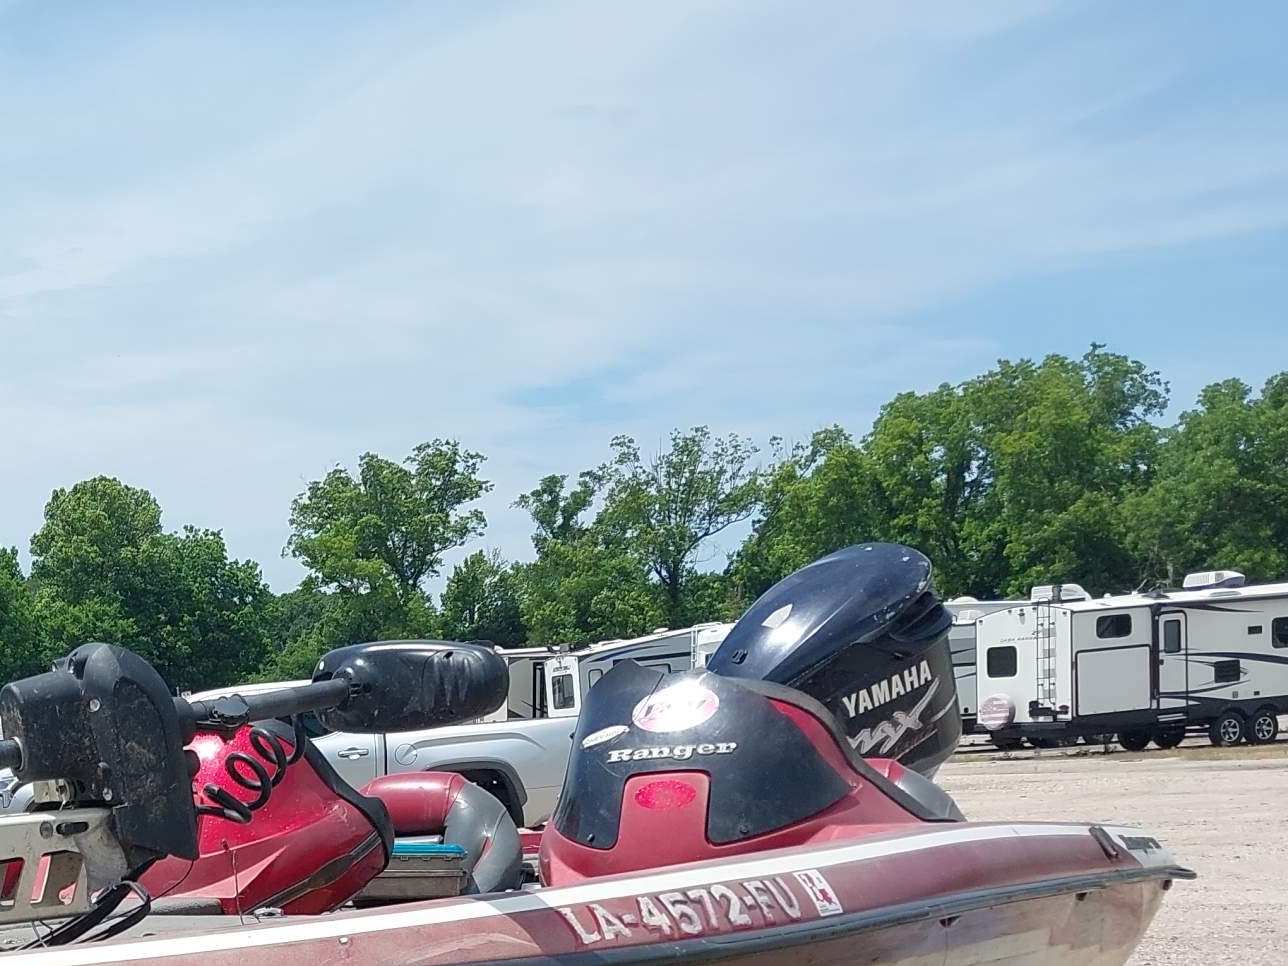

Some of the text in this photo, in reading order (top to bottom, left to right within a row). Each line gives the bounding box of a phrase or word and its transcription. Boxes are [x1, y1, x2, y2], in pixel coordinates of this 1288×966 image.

[841, 659, 932, 718] YAMAHA
[606, 742, 737, 764] Ranger
[558, 876, 801, 945] LA-4572-FU
